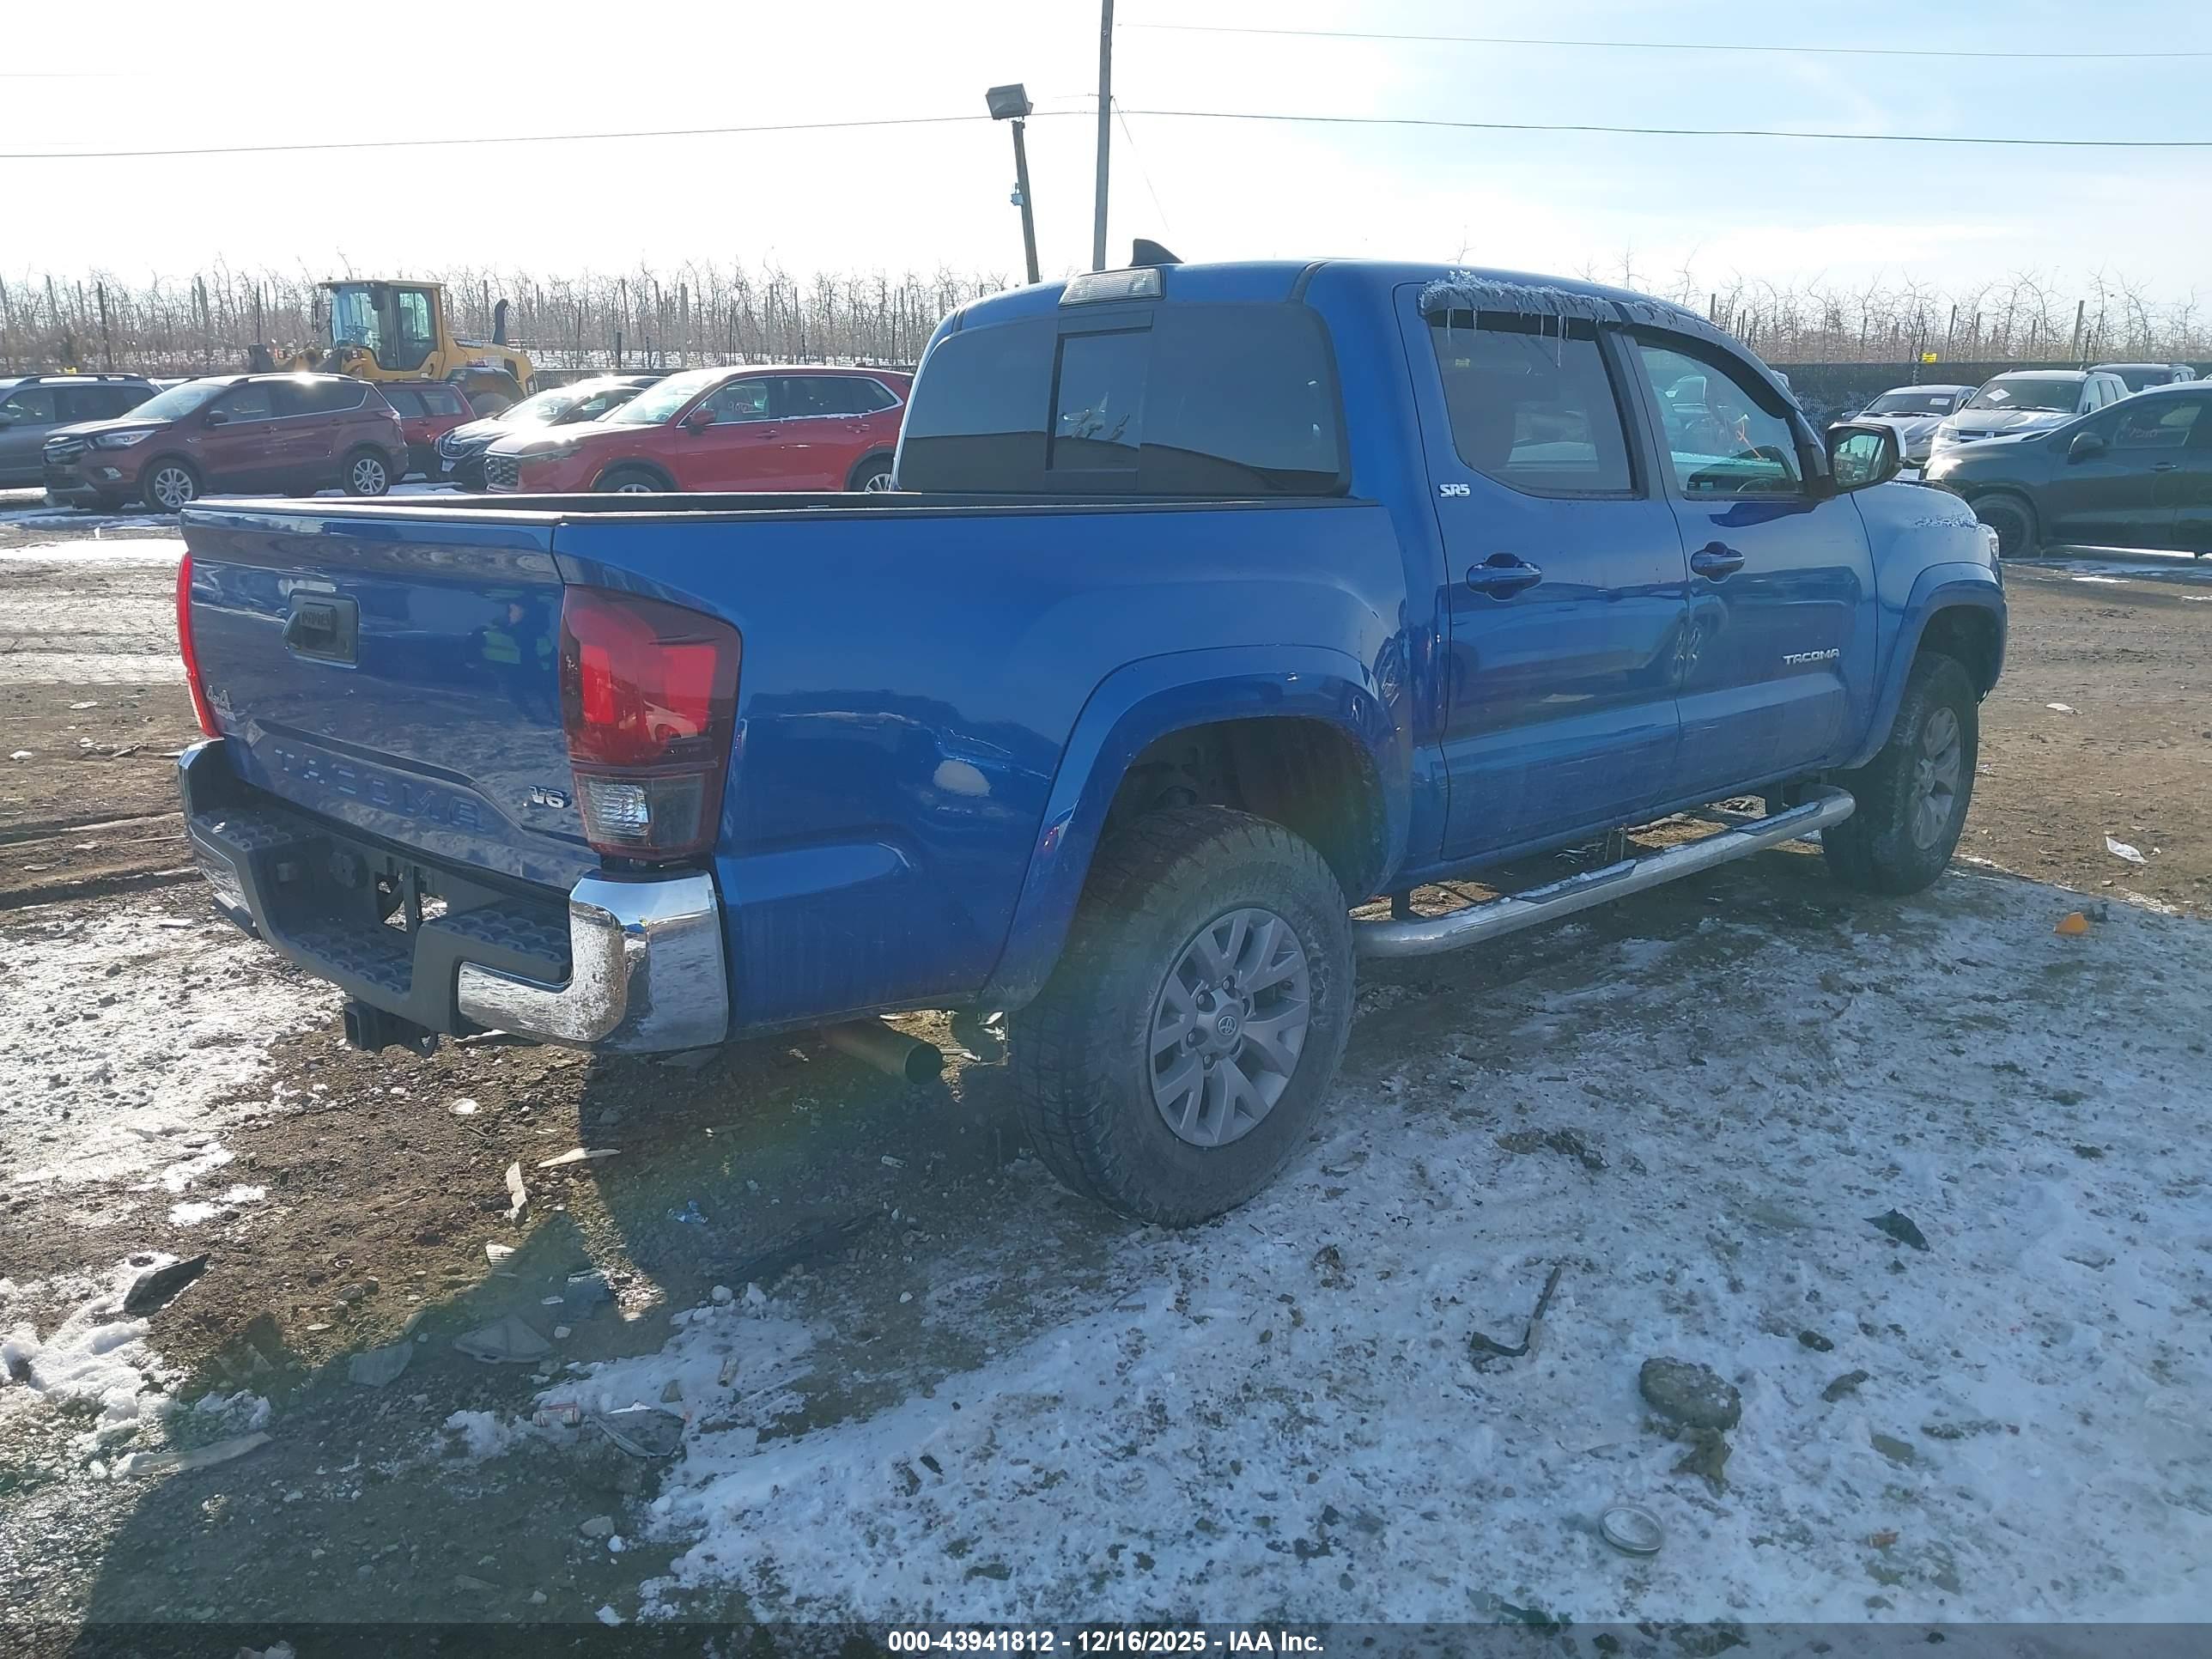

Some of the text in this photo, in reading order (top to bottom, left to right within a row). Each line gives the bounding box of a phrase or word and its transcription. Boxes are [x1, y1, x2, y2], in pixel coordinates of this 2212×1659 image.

[1439, 483, 1471, 497] SR5
[1782, 647, 1841, 665] TACOMA
[528, 785, 566, 809] V6
